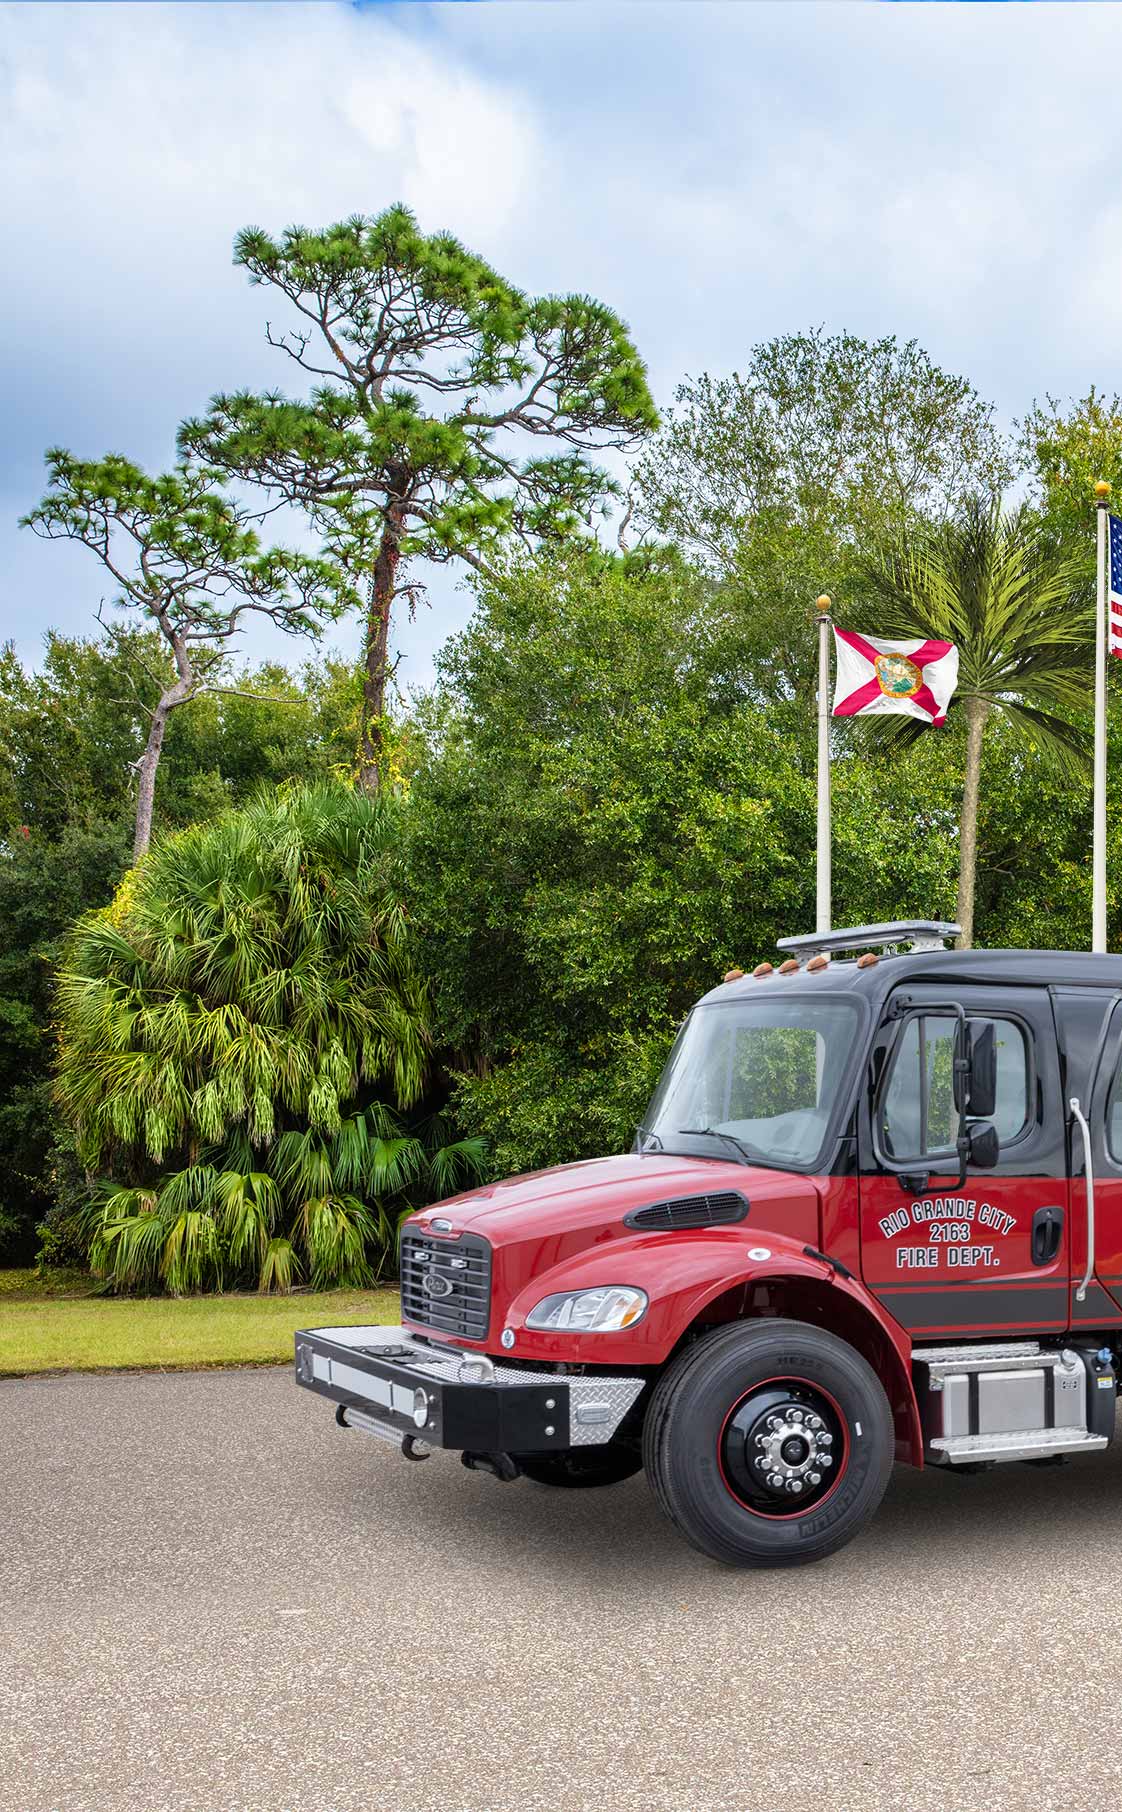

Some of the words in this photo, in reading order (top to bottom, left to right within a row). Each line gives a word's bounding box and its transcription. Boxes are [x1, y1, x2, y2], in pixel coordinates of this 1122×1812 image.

[879, 1209, 910, 1239] RIO
[911, 1199, 975, 1223] GRANDE
[979, 1204, 1016, 1236] CITY
[929, 1223, 971, 1243] 2163
[896, 1246, 938, 1268] FIRE
[947, 1246, 1000, 1267] DEPT.
